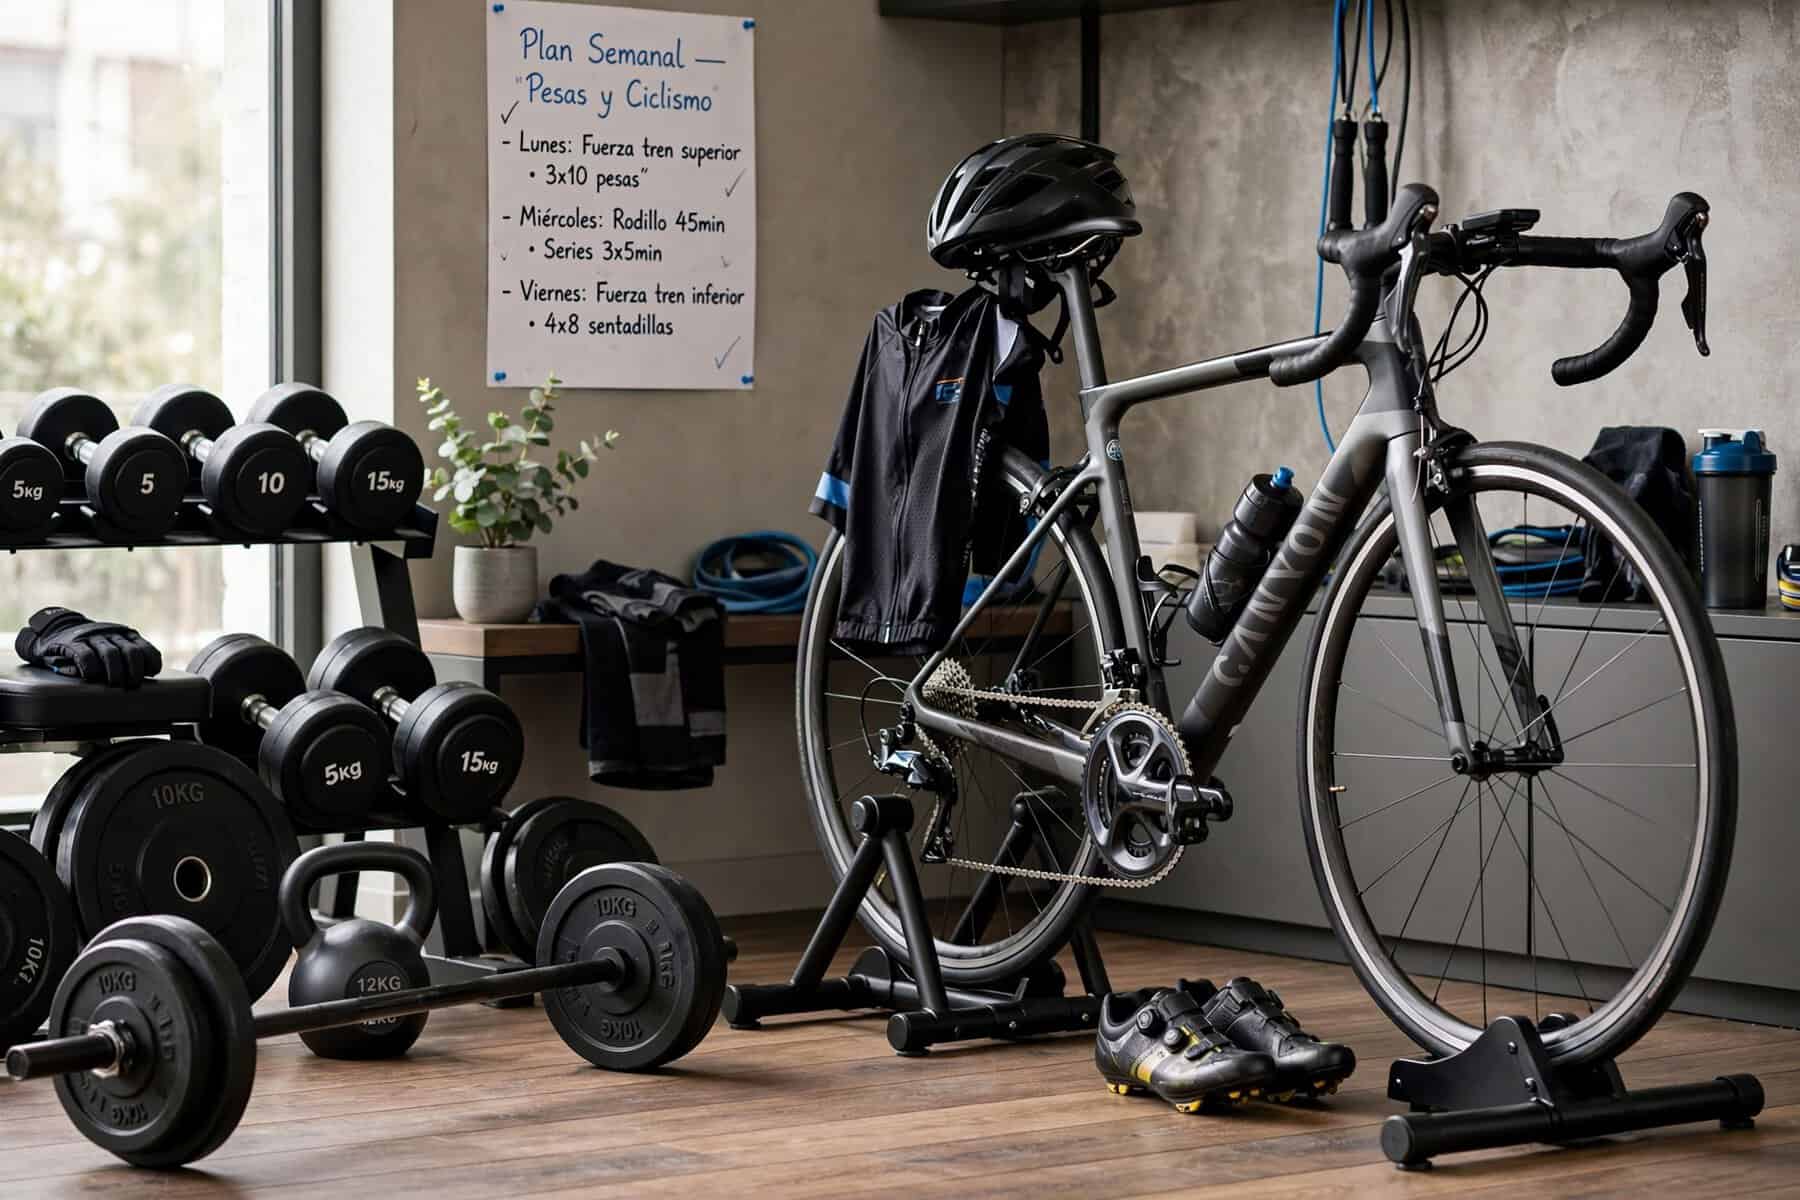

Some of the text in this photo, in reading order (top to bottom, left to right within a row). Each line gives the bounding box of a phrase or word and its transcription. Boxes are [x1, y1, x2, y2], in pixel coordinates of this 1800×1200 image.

[520, 27, 572, 62] Plan
[588, 33, 686, 69] Semanal
[598, 90, 613, 119] y
[626, 79, 713, 112] Ciclismo
[519, 130, 572, 154] Lunes:
[583, 134, 635, 157] Fuerza
[642, 137, 673, 158] tren
[681, 143, 741, 168] superior
[546, 164, 588, 186] 3x10
[519, 205, 603, 229] Miércoles:
[613, 207, 667, 231] Rodillo
[675, 210, 725, 233] 45min
[544, 238, 663, 262] Series 3x5min
[520, 279, 587, 302] Viernes:
[596, 281, 648, 304] Fuerza
[655, 283, 685, 304] tren
[692, 282, 745, 305] inferior
[544, 312, 674, 336] 4x8 sentadillas
[140, 473, 154, 494] 5
[258, 472, 285, 493] 10
[1212, 481, 1348, 687] CANYON
[151, 782, 205, 808] 10KG
[595, 895, 637, 918] 10KG
[357, 975, 402, 993] 12KG
